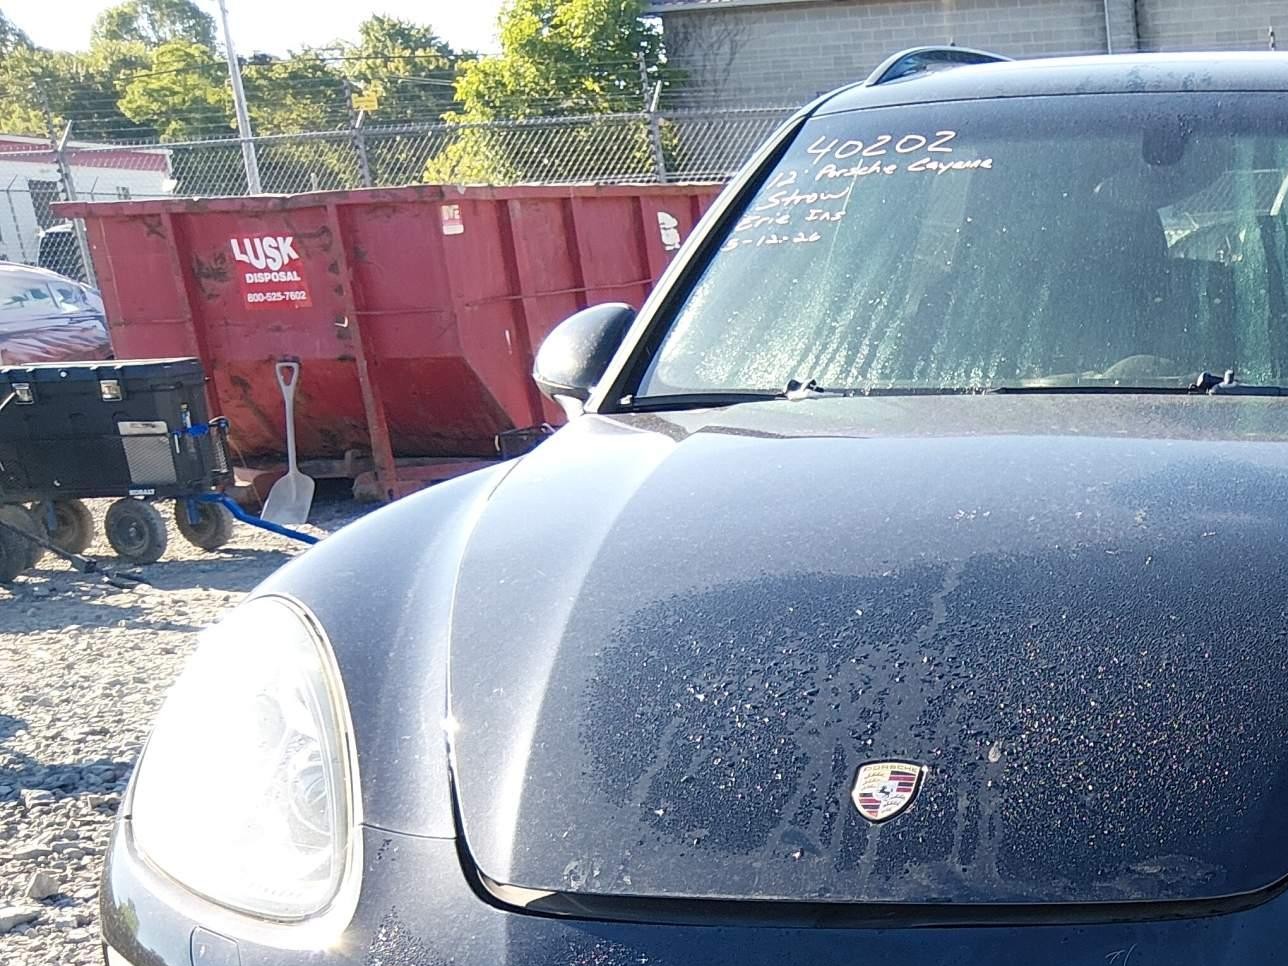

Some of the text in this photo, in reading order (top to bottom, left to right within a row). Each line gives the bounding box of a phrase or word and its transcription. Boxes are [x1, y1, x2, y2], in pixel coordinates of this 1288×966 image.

[807, 130, 956, 165] 40202
[230, 236, 300, 271] LUSK
[244, 271, 301, 284] DISPOSAL
[247, 290, 307, 303] 800-525-7602
[862, 764, 919, 773] PORSCHE
